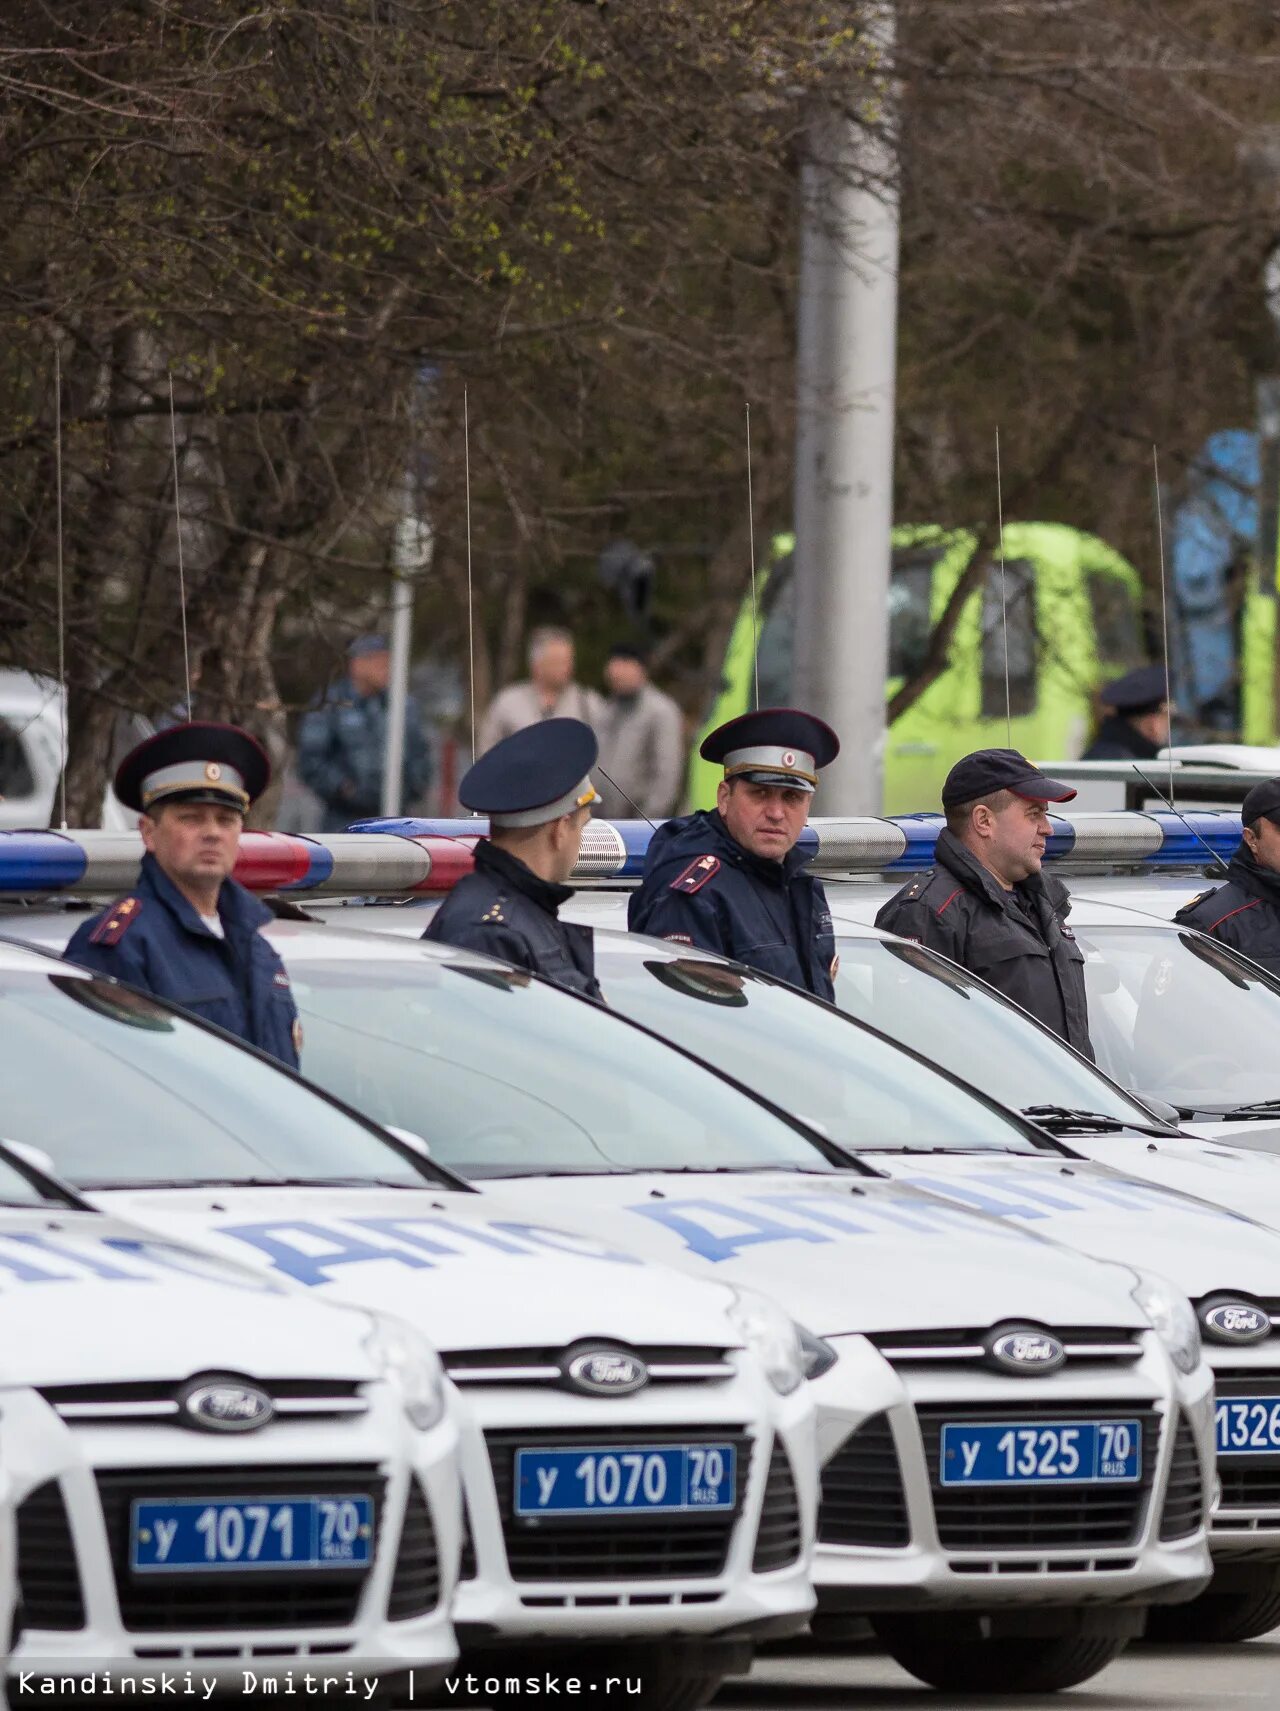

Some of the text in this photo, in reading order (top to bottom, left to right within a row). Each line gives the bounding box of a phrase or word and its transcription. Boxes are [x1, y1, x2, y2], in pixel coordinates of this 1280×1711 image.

[1224, 1308, 1258, 1330] Ford
[1012, 1337, 1052, 1360] Ford
[590, 1356, 634, 1383] Ford
[997, 1429, 1080, 1476] 1325
[1100, 1426, 1131, 1461] 70
[575, 1454, 667, 1505] 1070
[689, 1450, 723, 1487] 70
[1102, 1461, 1126, 1476] RUS
[195, 1505, 293, 1561] 1071
[319, 1501, 359, 1542] 70
